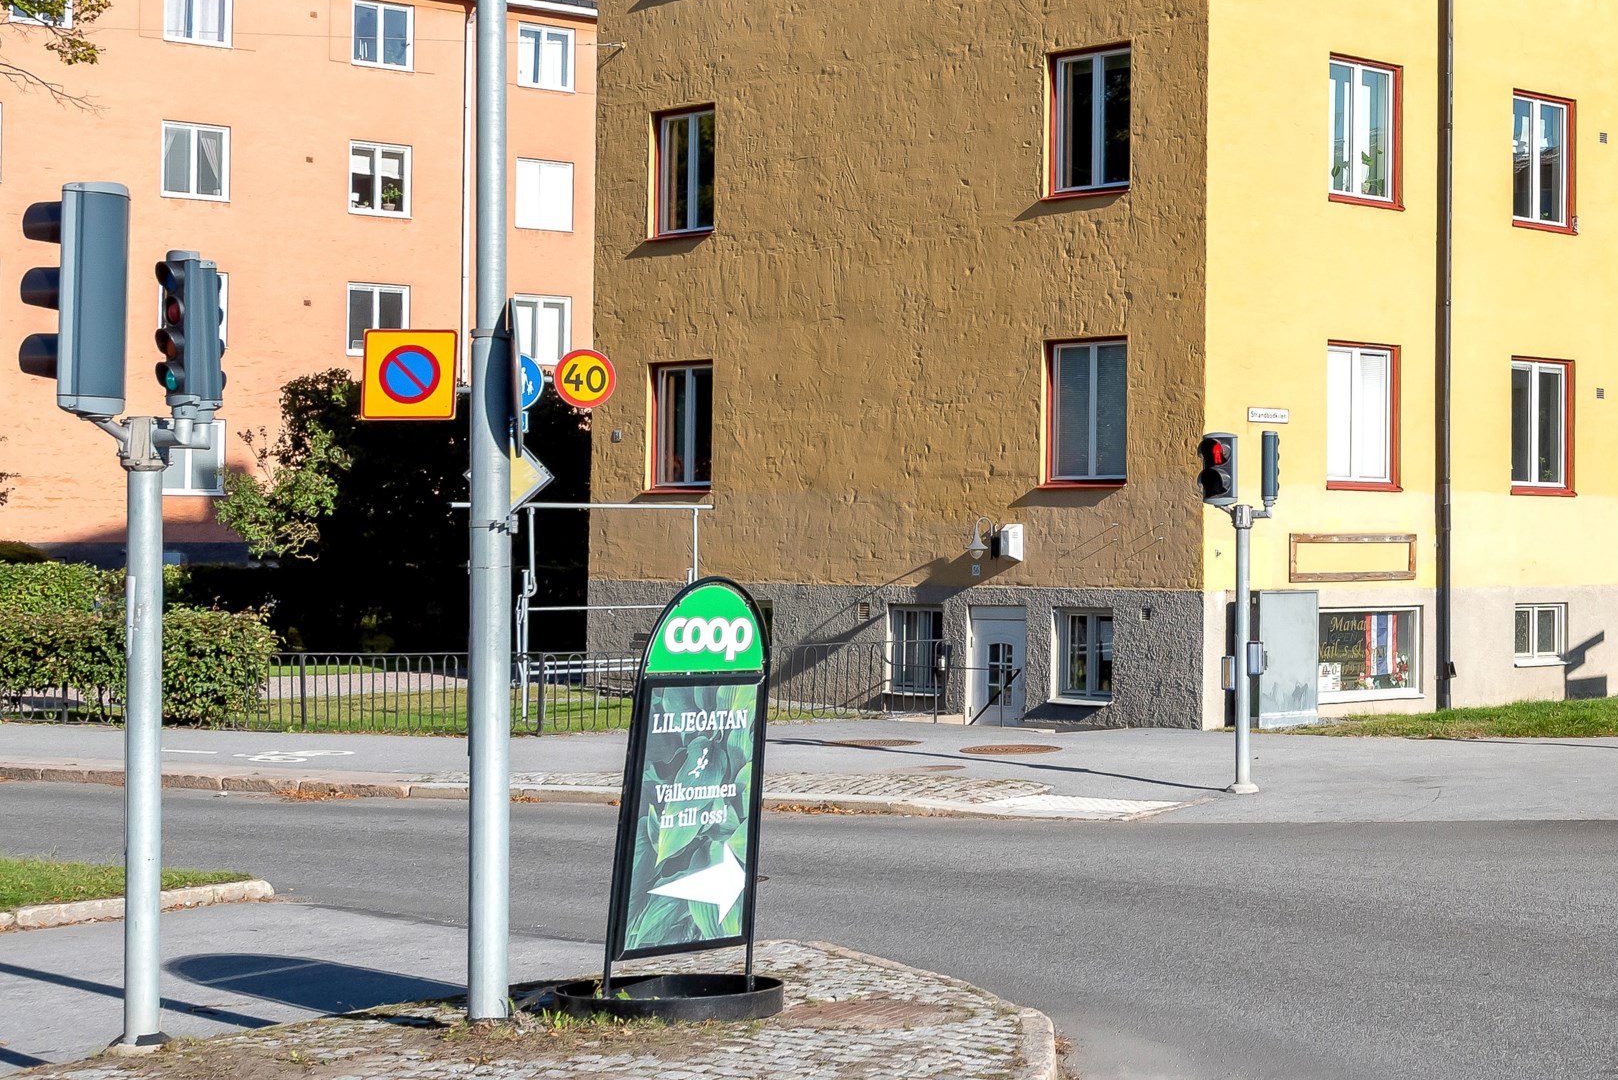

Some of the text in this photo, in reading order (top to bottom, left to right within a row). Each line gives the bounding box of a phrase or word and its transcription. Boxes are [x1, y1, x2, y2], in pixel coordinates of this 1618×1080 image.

[564, 364, 606, 393] 40
[665, 617, 753, 661] coop
[652, 710, 748, 733] LILJEGATAN
[656, 782, 737, 804] Välkommen
[660, 804, 728, 829] in till oss!
